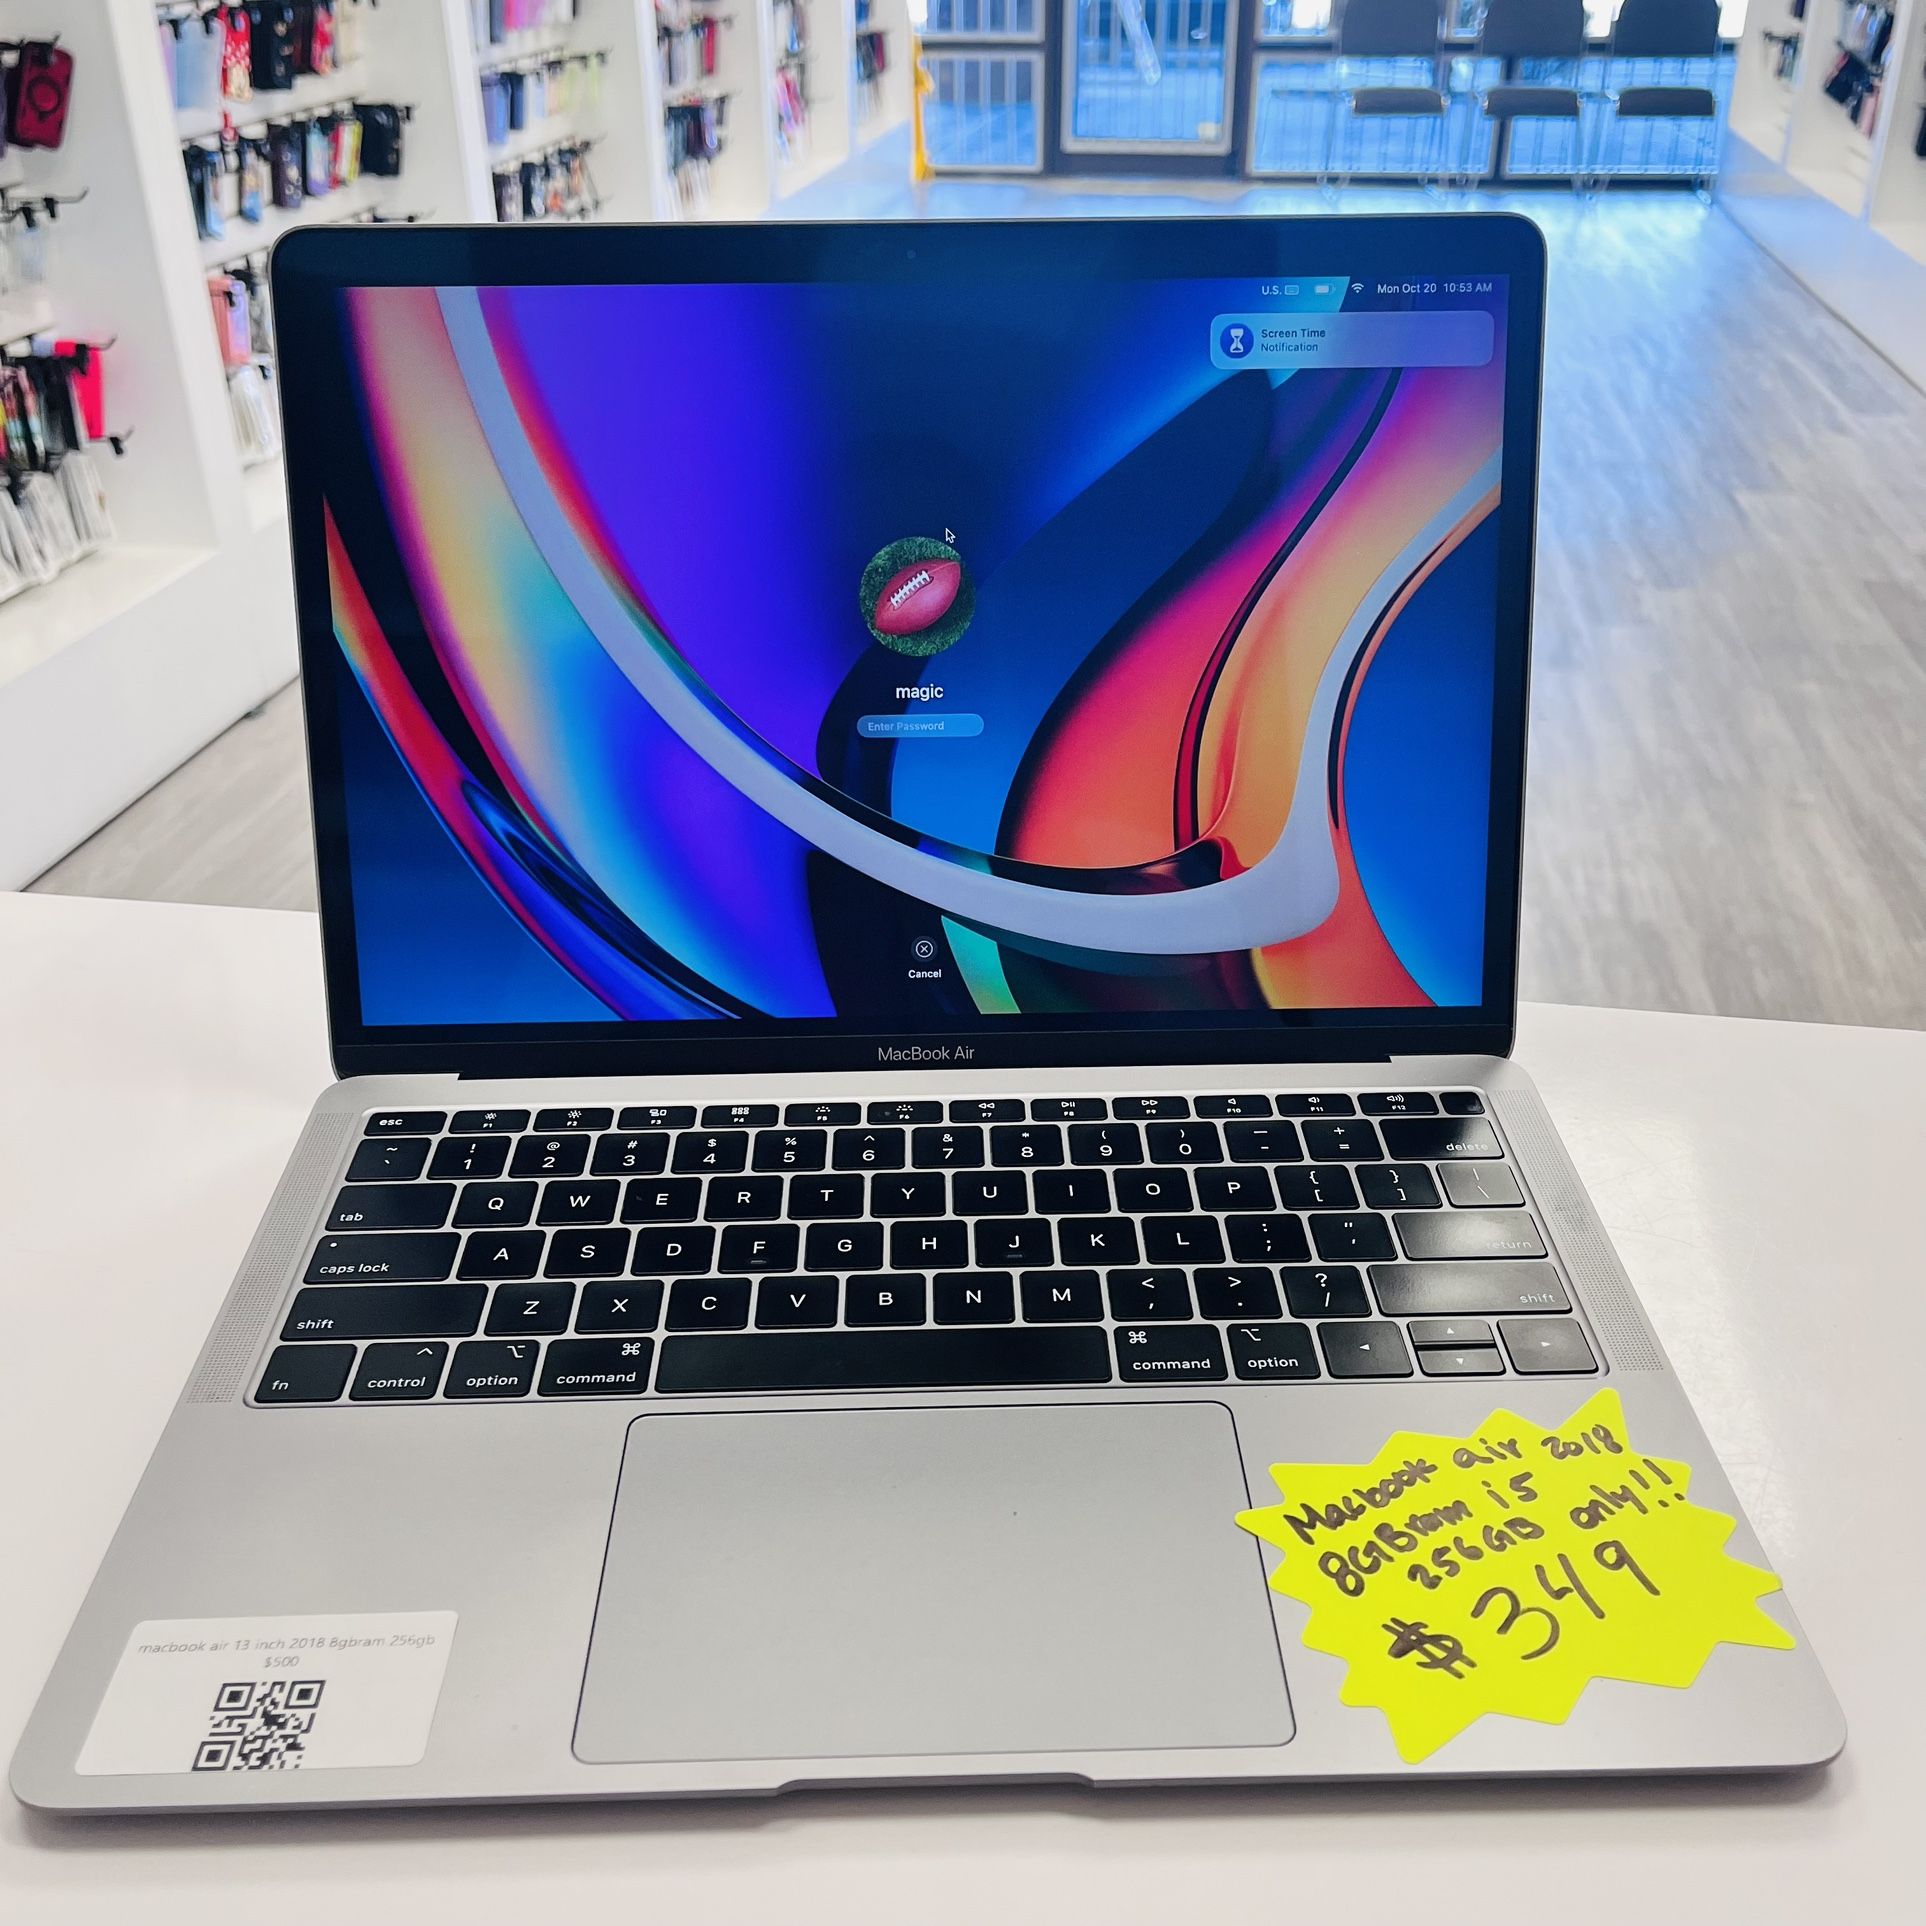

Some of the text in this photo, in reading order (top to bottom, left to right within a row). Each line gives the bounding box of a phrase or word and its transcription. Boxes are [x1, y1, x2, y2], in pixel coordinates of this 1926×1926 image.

[1261, 286, 1282, 295] U.S.
[1377, 282, 1492, 294] Mon Oct 20 10:53 AM
[1261, 328, 1326, 338] Screen Time
[1261, 342, 1318, 352] Notification
[895, 684, 944, 701] magic
[867, 721, 944, 731] Enter Password
[908, 969, 942, 979] Cancel
[877, 1046, 975, 1061] MacBook Air
[379, 1118, 403, 1126] esc
[1021, 1146, 1034, 1158] 8
[1099, 1144, 1113, 1157] 9
[1446, 1142, 1489, 1151] delete
[702, 1153, 717, 1164] 4
[783, 1151, 796, 1163] 5
[862, 1149, 875, 1162] 6
[942, 1147, 954, 1160] 7
[463, 1158, 472, 1170] 1
[541, 1156, 556, 1168] 2
[622, 1154, 636, 1167] 3
[901, 1187, 915, 1200] Y
[982, 1186, 998, 1199] U
[1068, 1184, 1074, 1197] I
[1145, 1183, 1161, 1196] O
[1227, 1181, 1241, 1194] P
[569, 1195, 591, 1208] W
[655, 1193, 669, 1206] E
[737, 1191, 752, 1204] R
[820, 1189, 834, 1202] T
[487, 1197, 504, 1211] Q
[339, 1212, 364, 1222] tab
[922, 1237, 937, 1250] H
[1008, 1235, 1020, 1249] J
[1090, 1233, 1106, 1247] K
[1176, 1232, 1190, 1246] L
[580, 1244, 596, 1259] S
[666, 1243, 682, 1257] D
[752, 1240, 766, 1254] F
[837, 1239, 853, 1253] G
[493, 1247, 509, 1261] A
[319, 1262, 390, 1275] caps lock
[790, 1293, 807, 1308] V
[878, 1292, 894, 1306] B
[966, 1289, 982, 1304] N
[1052, 1287, 1072, 1302] M
[1519, 1292, 1556, 1304] shift
[522, 1300, 540, 1315] Z
[611, 1298, 629, 1313] X
[701, 1296, 717, 1311] C
[296, 1318, 334, 1330] shift
[1132, 1358, 1211, 1371] command
[1247, 1356, 1299, 1370] option
[272, 1379, 289, 1390] fn
[367, 1376, 426, 1388] control
[466, 1374, 519, 1388] option
[556, 1371, 637, 1385] command
[1283, 1423, 1624, 1545] Macbook air 2018
[1407, 1516, 1544, 1589] 256GB
[138, 1634, 436, 1654] macbook air 13 inch 2018 8gbram 256gb
[264, 1655, 300, 1668] $500
